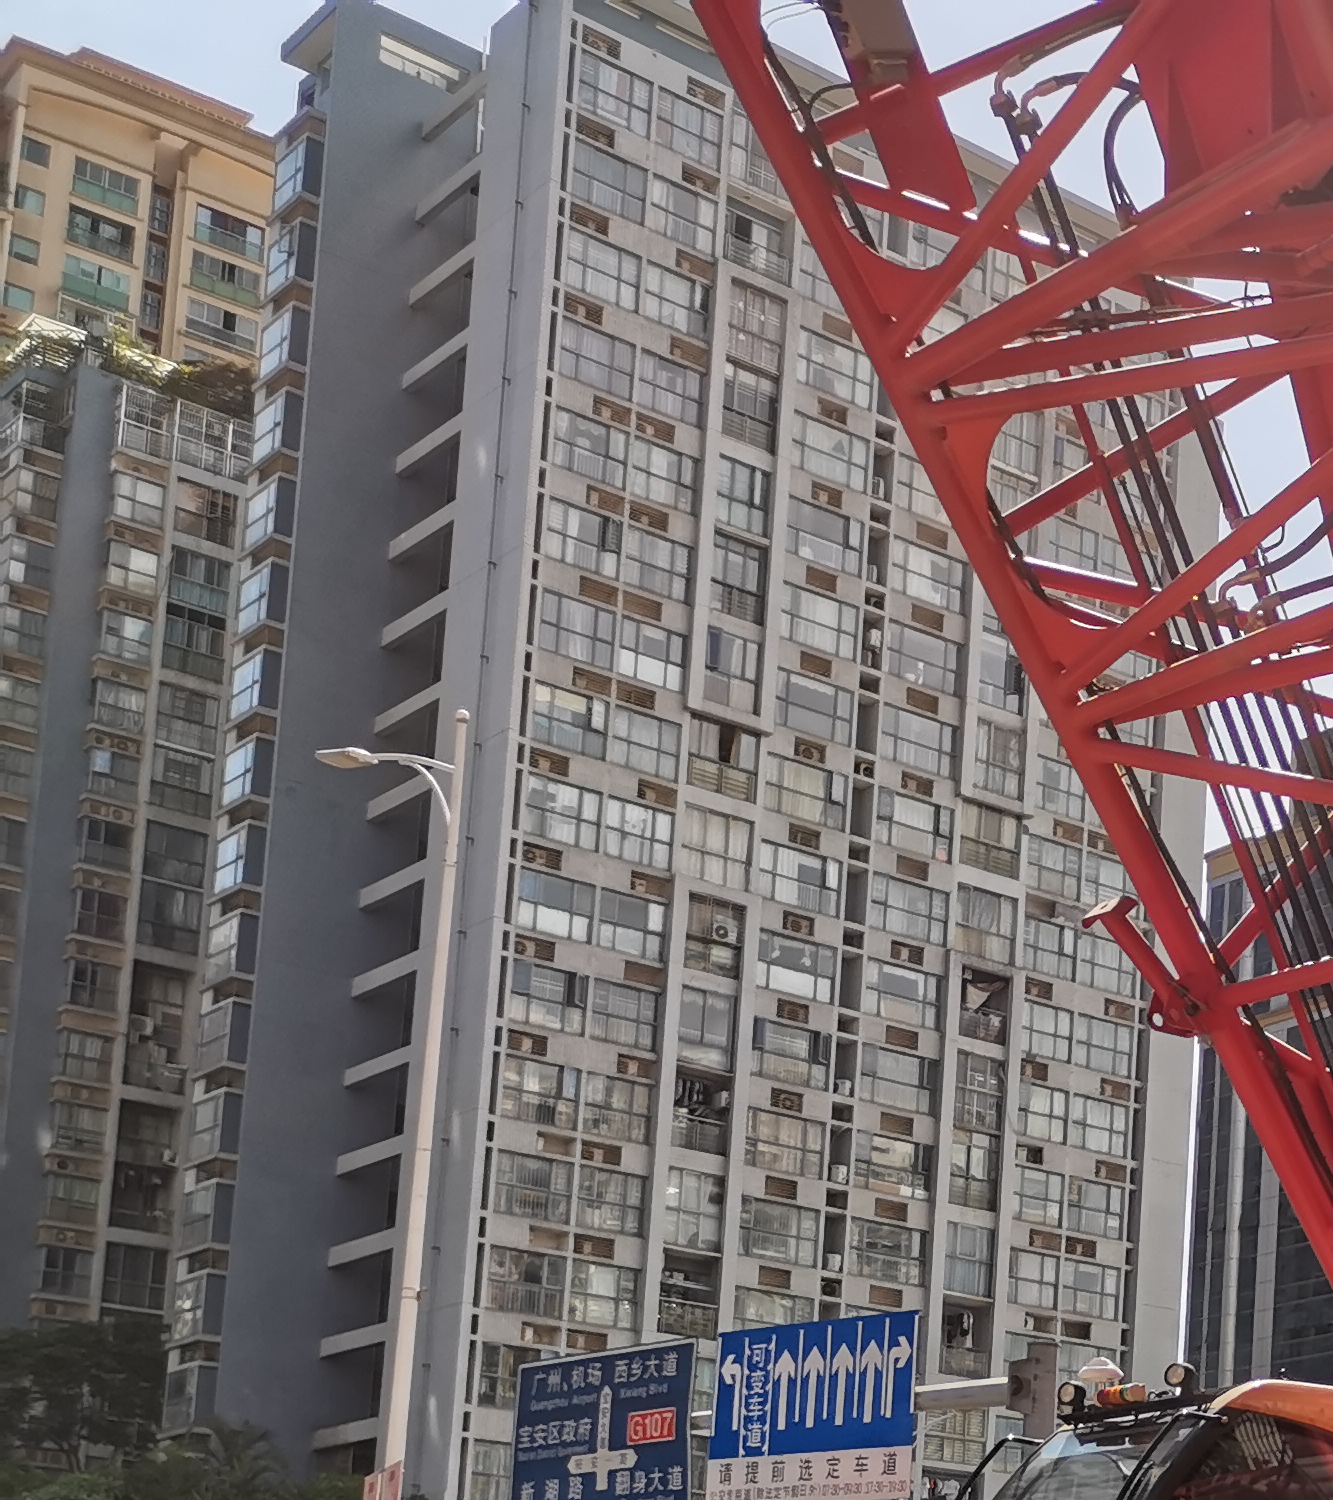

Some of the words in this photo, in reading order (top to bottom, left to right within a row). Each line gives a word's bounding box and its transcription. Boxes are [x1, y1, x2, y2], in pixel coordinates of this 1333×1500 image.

[613, 1350, 679, 1384] 西乡大道
[746, 1343, 768, 1447] 可变车道
[518, 1417, 593, 1449] 宝安区政府
[630, 1412, 673, 1440] G107
[615, 1465, 684, 1496] 翻身大道
[719, 1452, 898, 1486] 请提前选定车道
